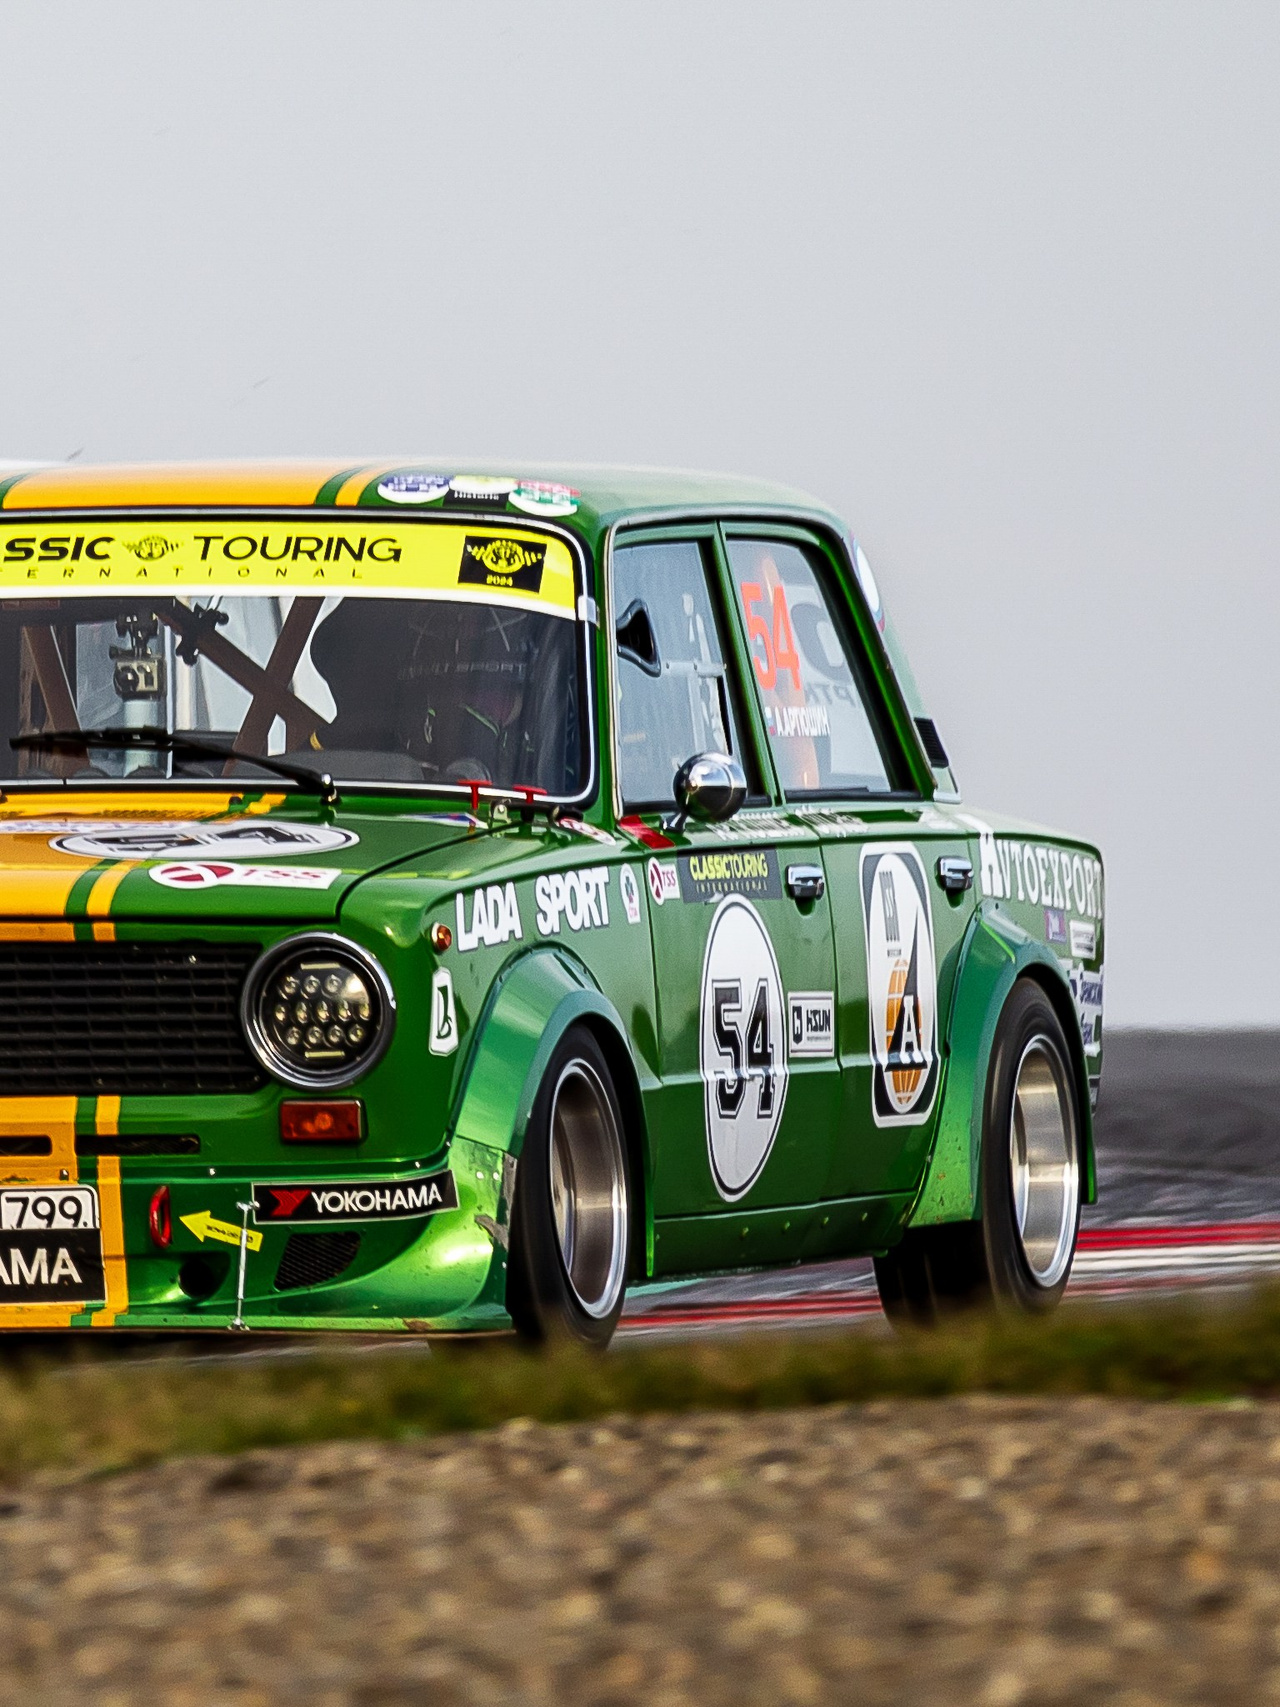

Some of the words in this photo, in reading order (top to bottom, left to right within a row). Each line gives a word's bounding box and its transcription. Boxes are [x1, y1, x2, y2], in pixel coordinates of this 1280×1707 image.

[193, 535, 403, 563] TOURING
[740, 582, 801, 691] 54
[455, 881, 523, 951] LADA
[535, 866, 609, 935] SPORT
[711, 977, 775, 1120] 54
[311, 1182, 443, 1215] YOKOHAMA
